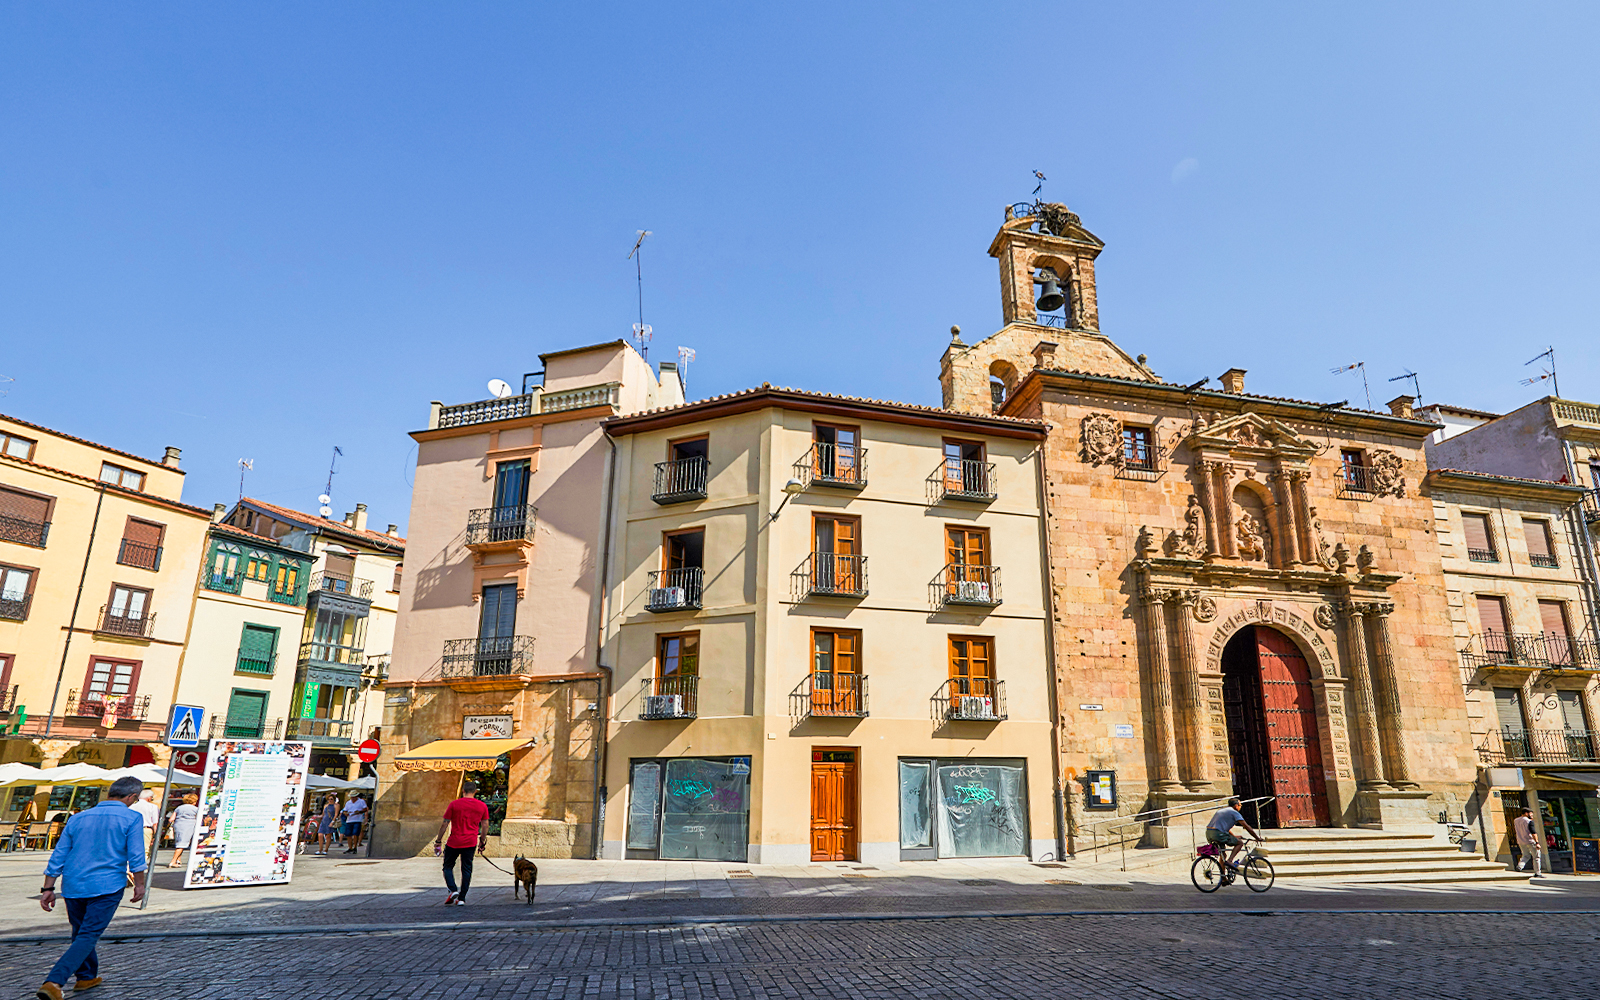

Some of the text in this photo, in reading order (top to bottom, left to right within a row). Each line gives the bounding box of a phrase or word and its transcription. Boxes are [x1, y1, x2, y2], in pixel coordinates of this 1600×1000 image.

[395, 761, 425, 769] Regalos
[448, 760, 494, 769] CORRILLO
[222, 818, 232, 840] ARTES
[228, 789, 238, 812] CALLE
